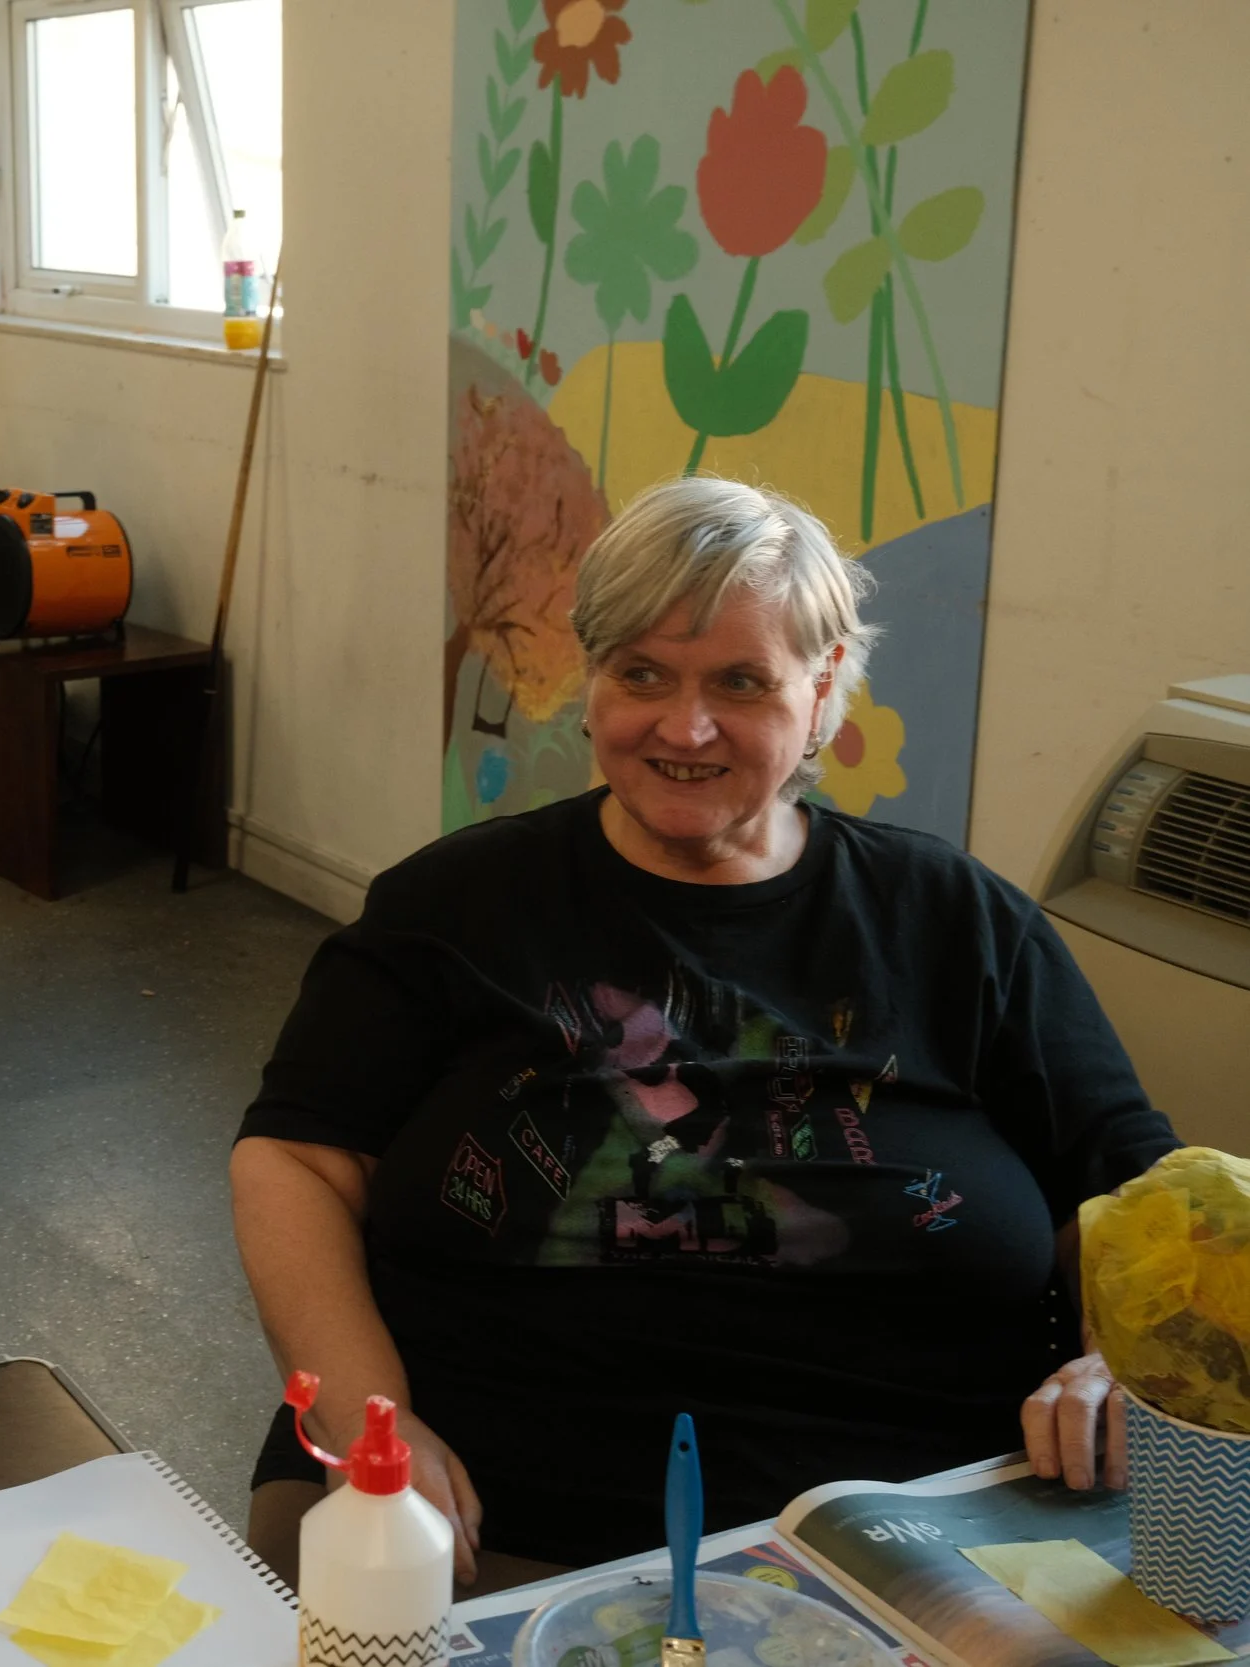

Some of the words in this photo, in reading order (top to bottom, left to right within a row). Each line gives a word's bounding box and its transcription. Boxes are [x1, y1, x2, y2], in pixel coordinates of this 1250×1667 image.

[453, 1145, 497, 1196] OPEN
[521, 1129, 564, 1188] CAFE
[465, 1186, 492, 1220] HRS
[861, 1517, 942, 1544] GWR
